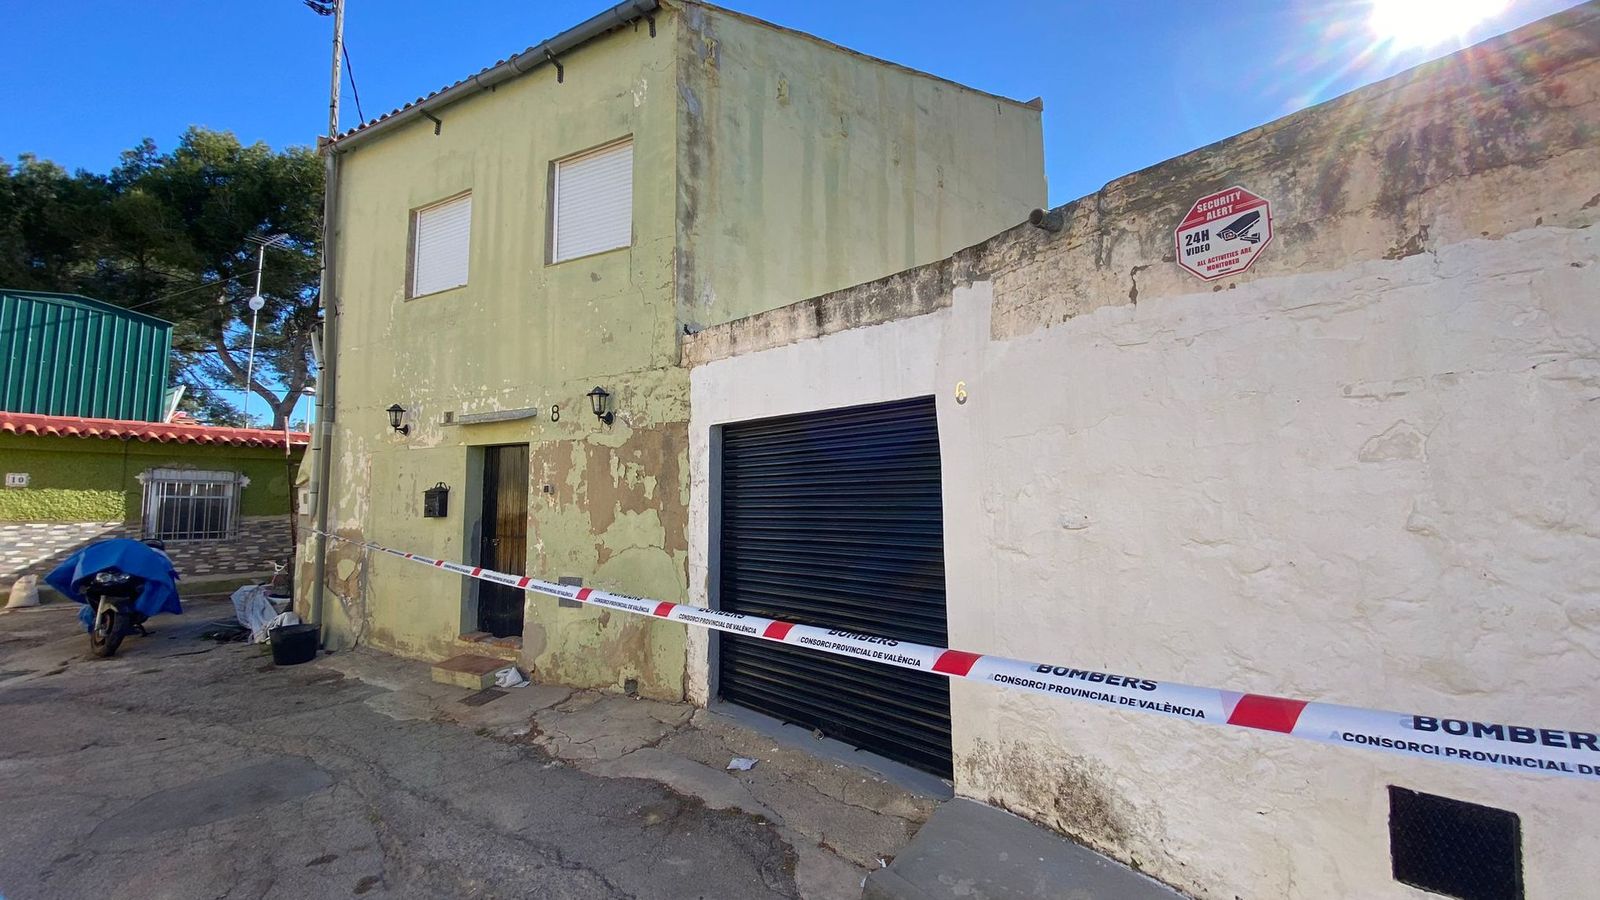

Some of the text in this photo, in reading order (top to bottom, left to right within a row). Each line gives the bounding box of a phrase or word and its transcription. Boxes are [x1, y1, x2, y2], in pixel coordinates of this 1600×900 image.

[1197, 191, 1241, 213] SECURITY
[1207, 205, 1233, 221] ALERT
[1185, 229, 1210, 247] 24H
[1186, 243, 1210, 257] VIDEO
[1208, 250, 1239, 264] ACTIVITIES
[1240, 247, 1252, 255] ARE
[1207, 258, 1240, 271] MONITORED
[955, 381, 967, 405] 6
[551, 404, 559, 422] 8
[800, 636, 921, 667] CONSORCI PROVINCIAL DE VALÈNCIA
[1037, 663, 1158, 692] BOMBERS
[994, 673, 1206, 719] CONSORCI PROVINCIAL DE VALÈNCIA
[1342, 732, 1440, 756] CONSORCI
[1445, 747, 1574, 773] PROVINCIAL
